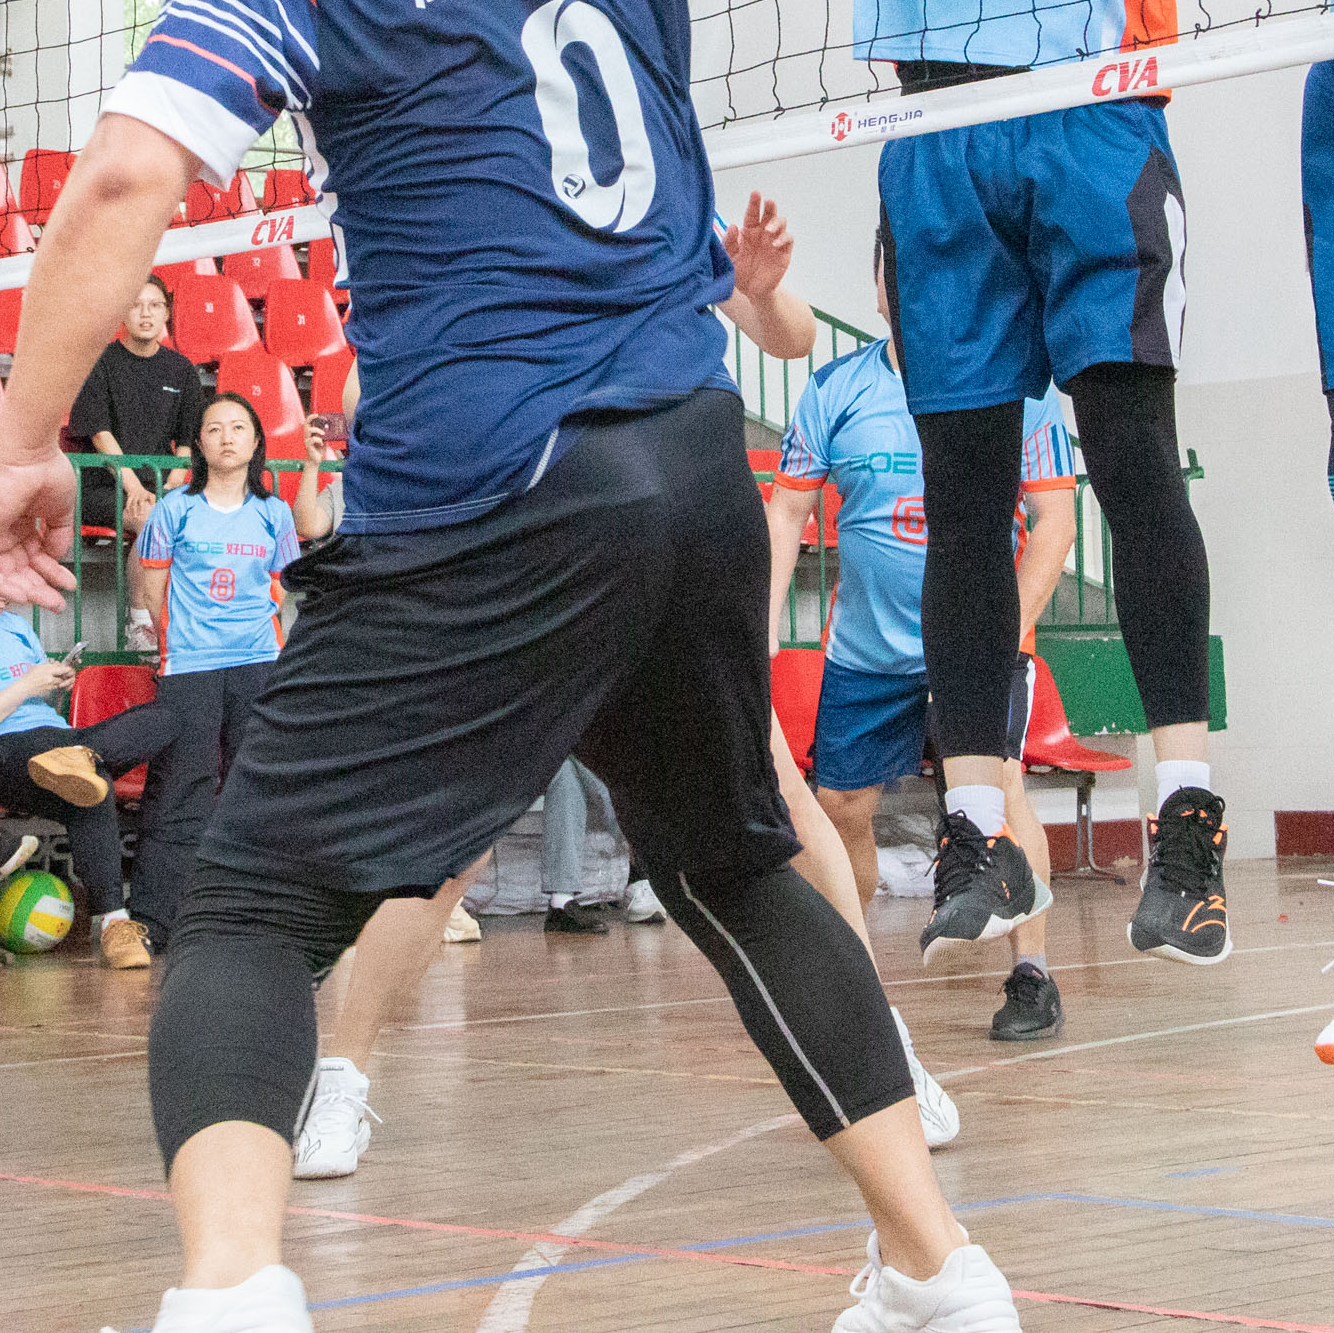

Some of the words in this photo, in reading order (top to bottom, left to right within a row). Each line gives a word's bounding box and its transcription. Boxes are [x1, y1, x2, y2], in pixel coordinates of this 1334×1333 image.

[1091, 56, 1159, 97] CVA
[857, 109, 924, 128] HENGJIA
[250, 215, 295, 246] CVA
[226, 543, 267, 558] 好口语
[209, 568, 236, 602] 8
